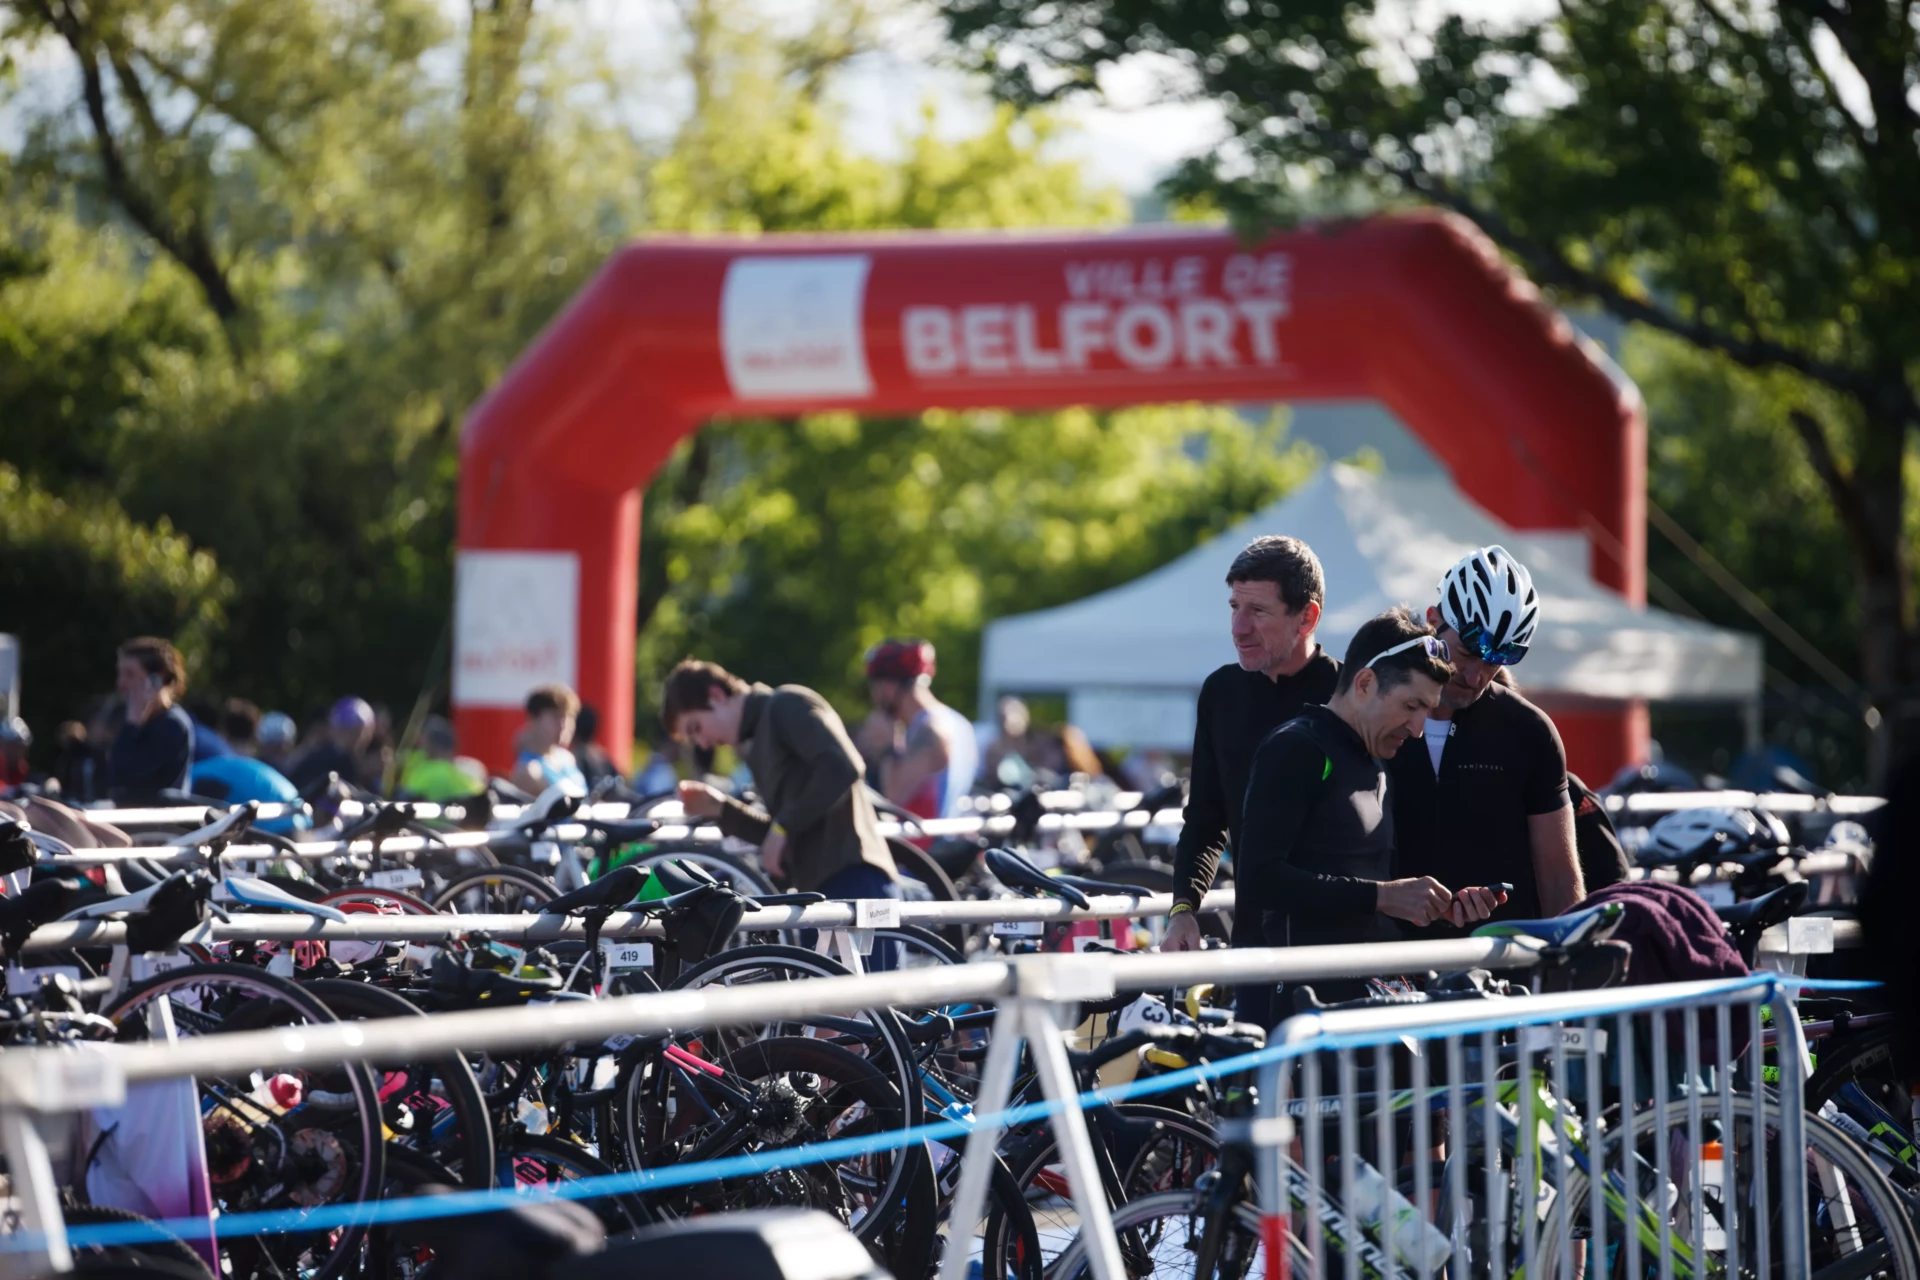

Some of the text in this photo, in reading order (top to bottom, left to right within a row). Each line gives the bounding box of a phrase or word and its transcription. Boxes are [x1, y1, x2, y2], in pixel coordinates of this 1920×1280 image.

[1065, 253, 1292, 299] VILLE DE
[902, 300, 1291, 375] BELFORT
[620, 951, 639, 962] 419
